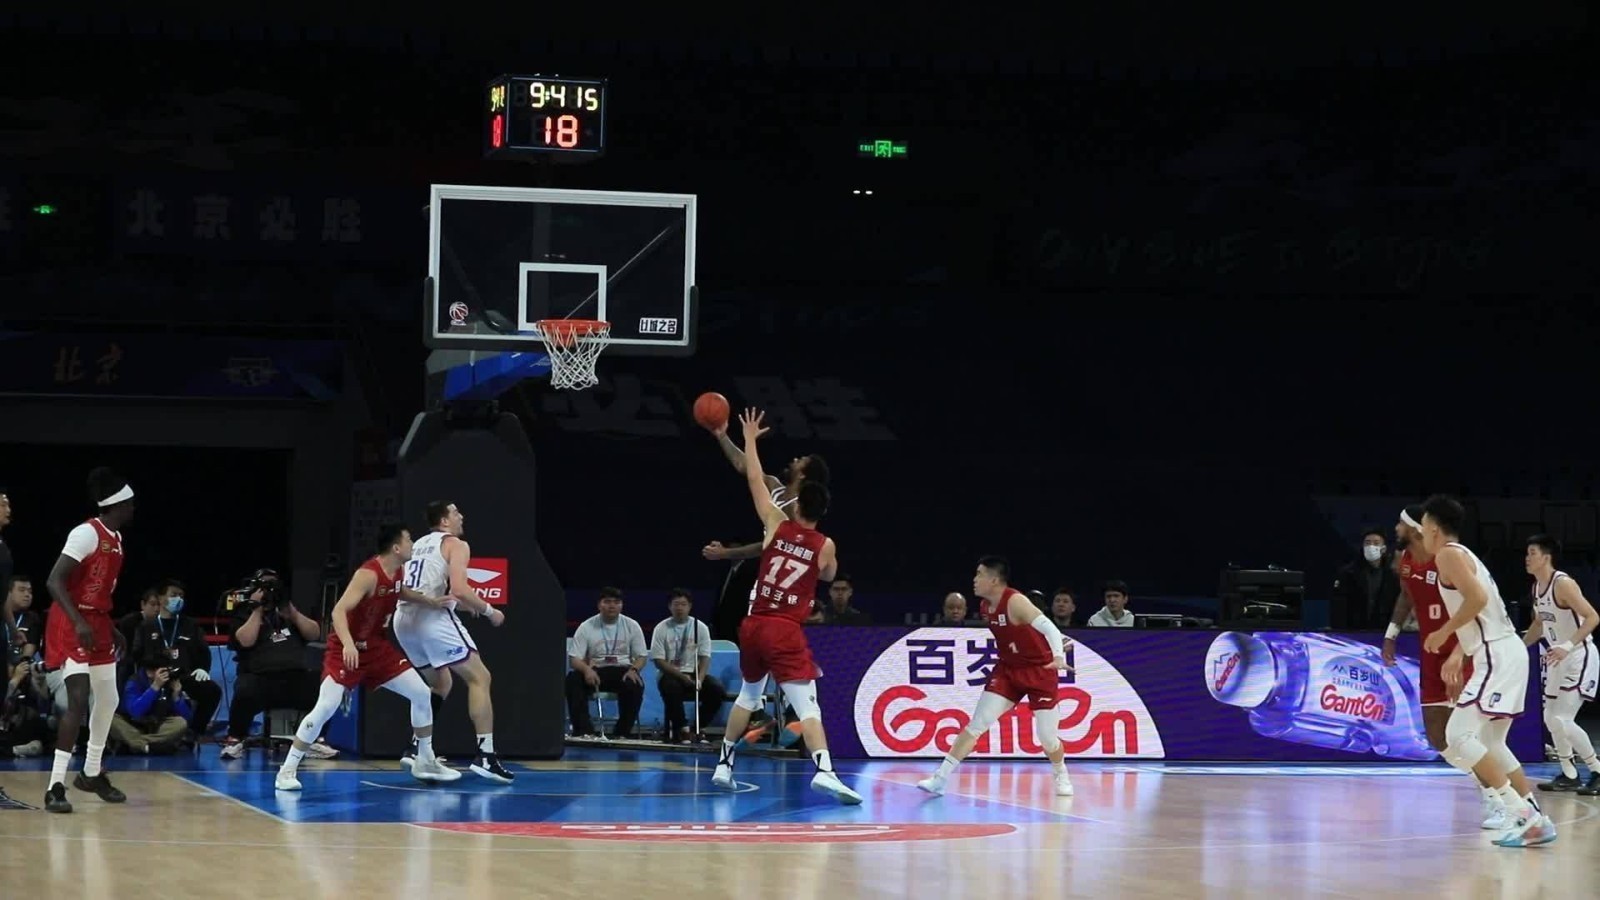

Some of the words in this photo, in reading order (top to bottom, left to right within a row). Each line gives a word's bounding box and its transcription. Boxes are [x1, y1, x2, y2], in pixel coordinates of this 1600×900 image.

[545, 114, 578, 148] 18
[407, 559, 425, 588] 31
[763, 555, 810, 589] 17
[1428, 604, 1441, 619] 0
[1349, 665, 1381, 685] 百岁山
